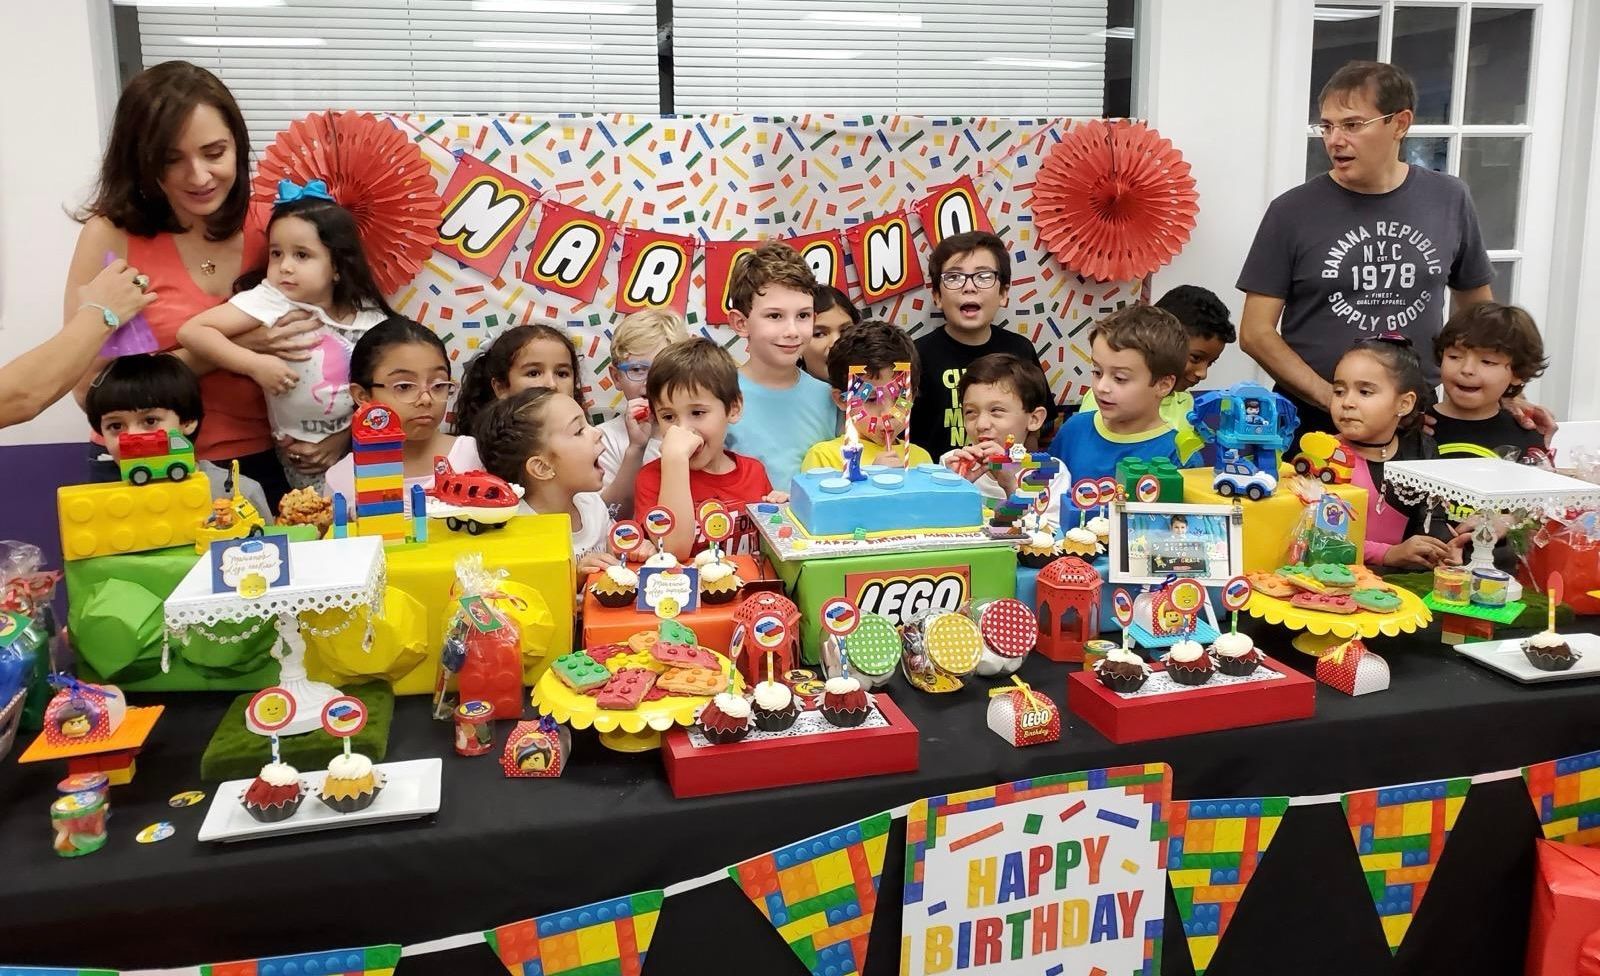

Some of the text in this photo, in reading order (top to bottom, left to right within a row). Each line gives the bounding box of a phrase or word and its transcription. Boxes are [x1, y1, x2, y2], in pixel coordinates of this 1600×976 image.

[437, 180, 976, 310] MARANO
[1321, 221, 1442, 279] BANANA REPUBLIC
[1351, 263, 1416, 291] 1978
[1328, 290, 1432, 332] SUPPLY GOODS
[854, 379, 904, 397] HAPPY
[858, 577, 962, 628] LEGO
[1021, 709, 1049, 728] LEGO
[1023, 728, 1049, 738] Birthday
[967, 835, 1110, 909] HAPPY
[924, 890, 1144, 976] BIRTHDAY
